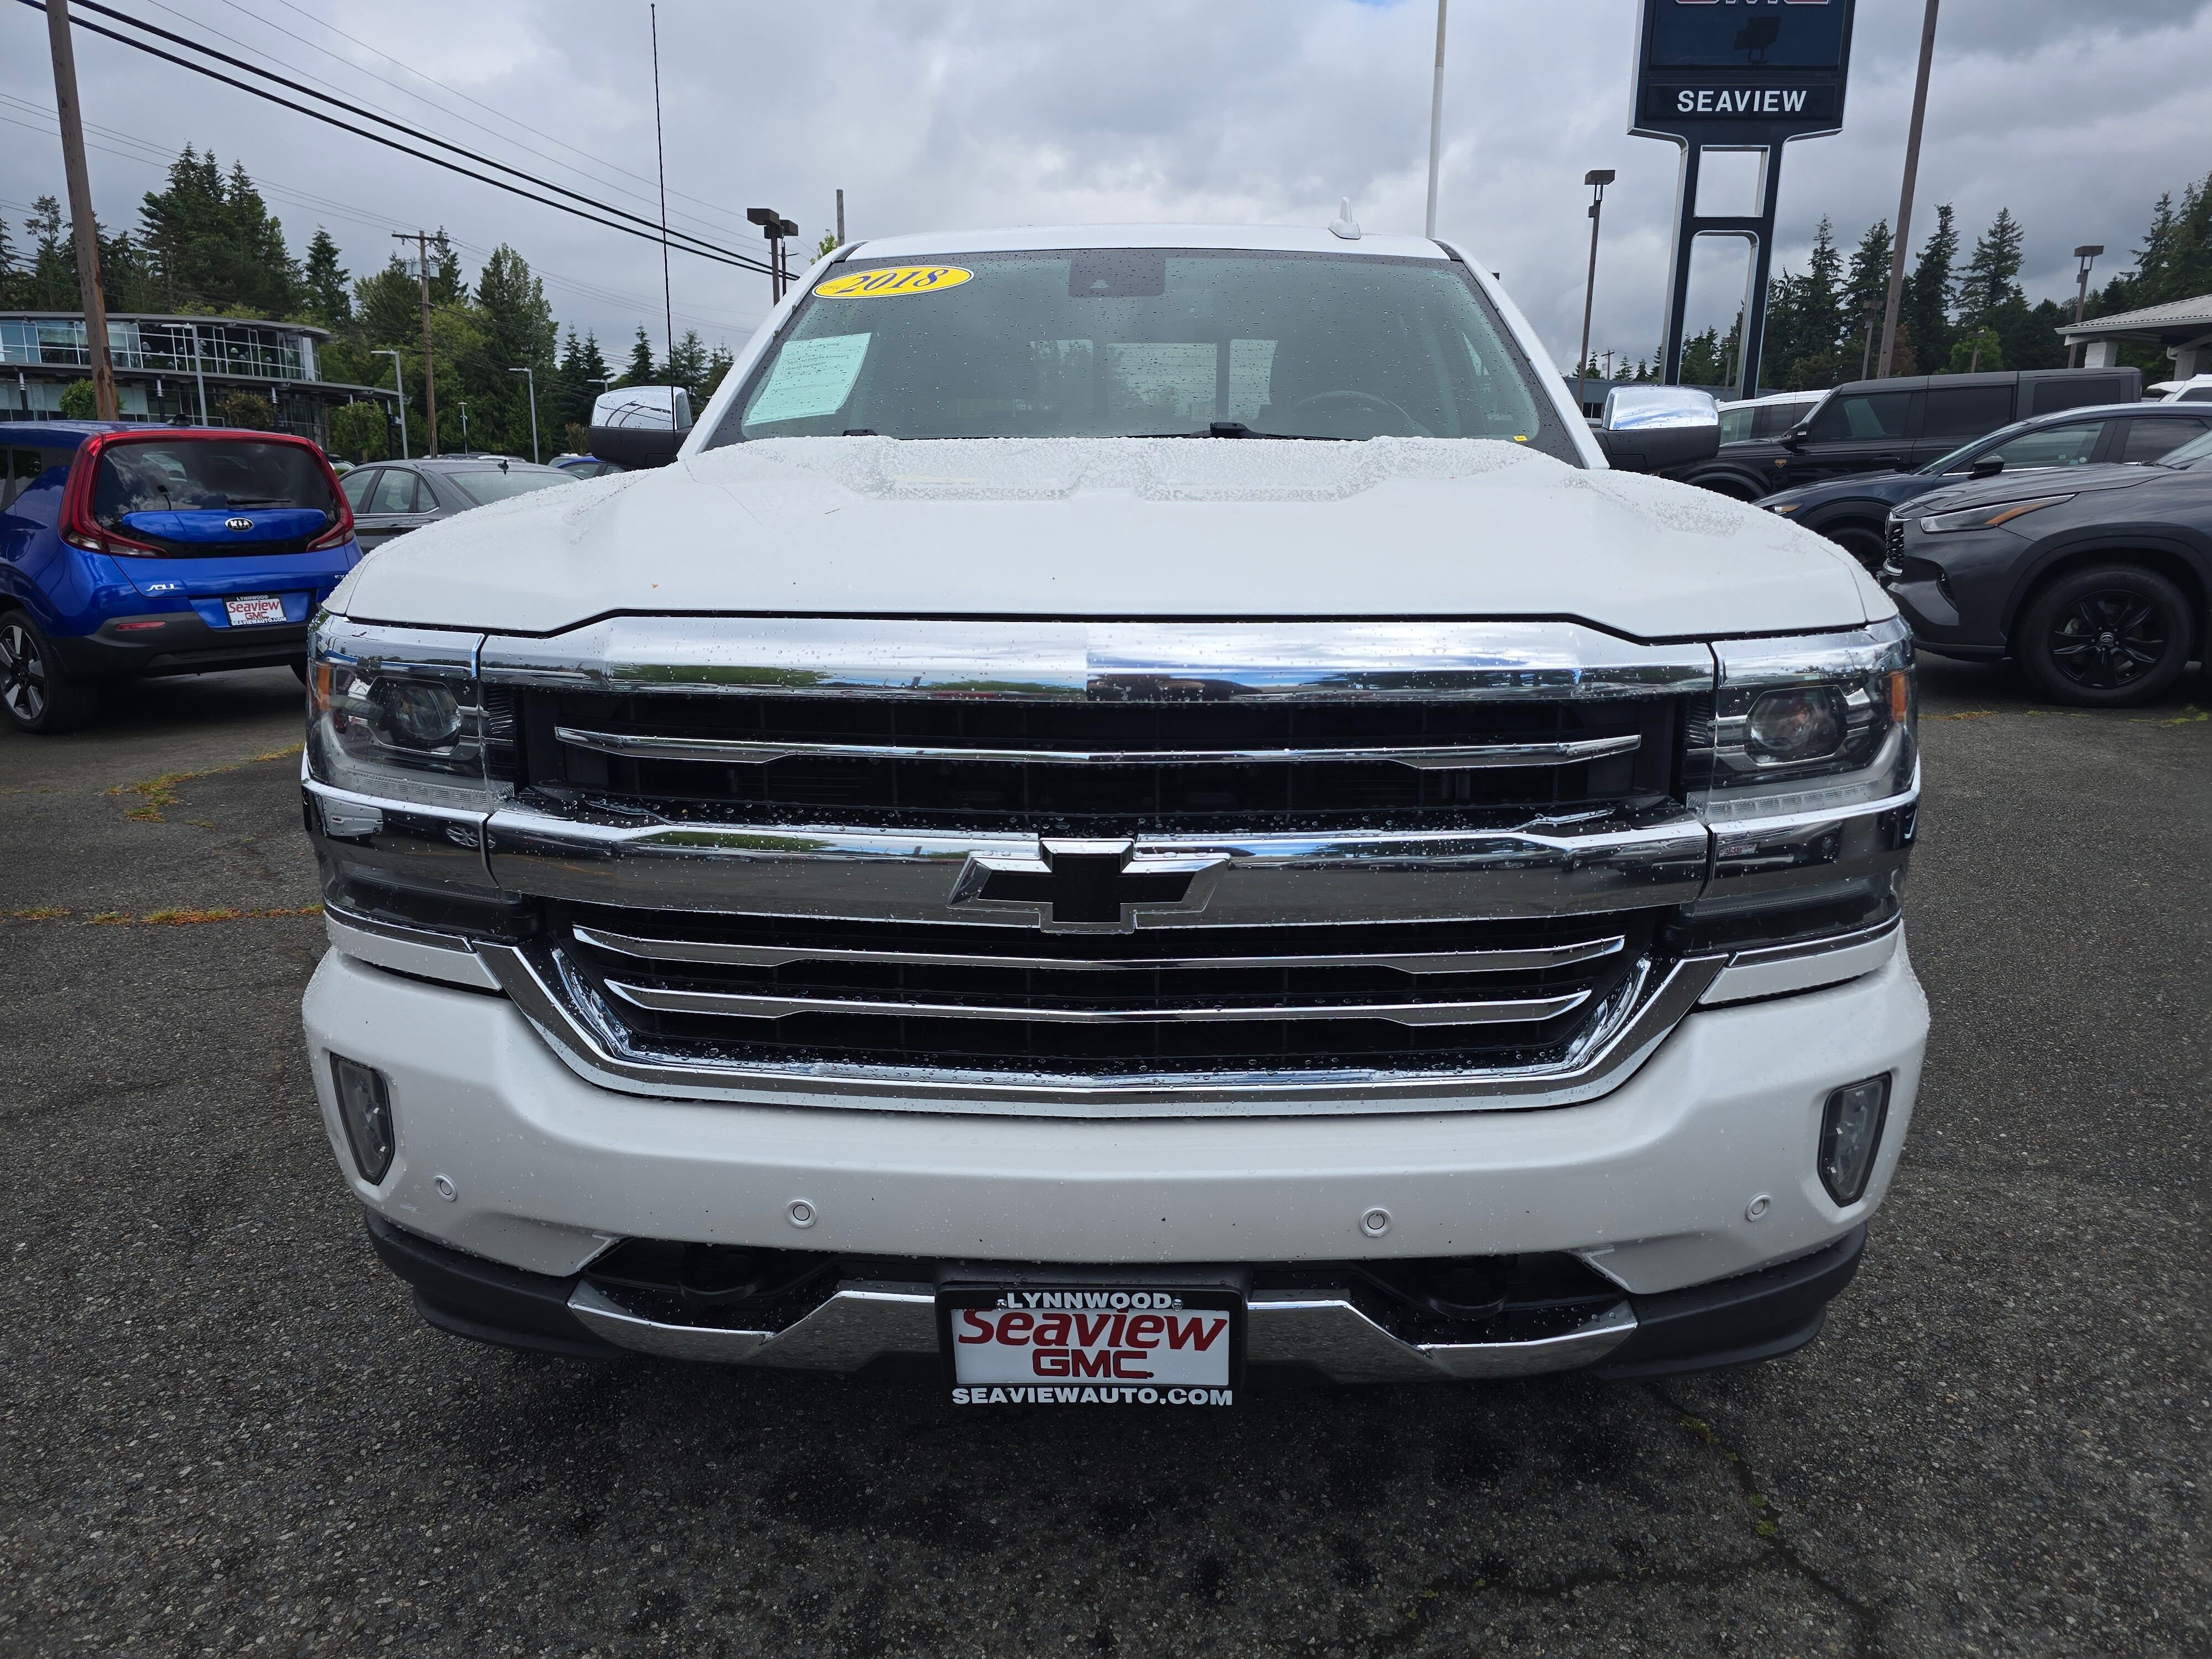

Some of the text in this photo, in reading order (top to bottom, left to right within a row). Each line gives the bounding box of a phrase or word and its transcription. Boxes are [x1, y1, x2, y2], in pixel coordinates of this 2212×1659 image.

[1677, 90, 1807, 112] SEAVIEW
[833, 269, 949, 294] 2018
[229, 520, 250, 529] KIA
[229, 601, 280, 613] Seaview
[245, 611, 269, 620] GMC
[231, 617, 286, 626] SEAVIEWAUTO.COM
[1007, 1292, 1172, 1309] LYNNWOOD
[958, 1307, 1228, 1352] Seaview
[1032, 1348, 1148, 1379] GMC
[952, 1387, 1233, 1406] SEAVIEWAUTO.COM
